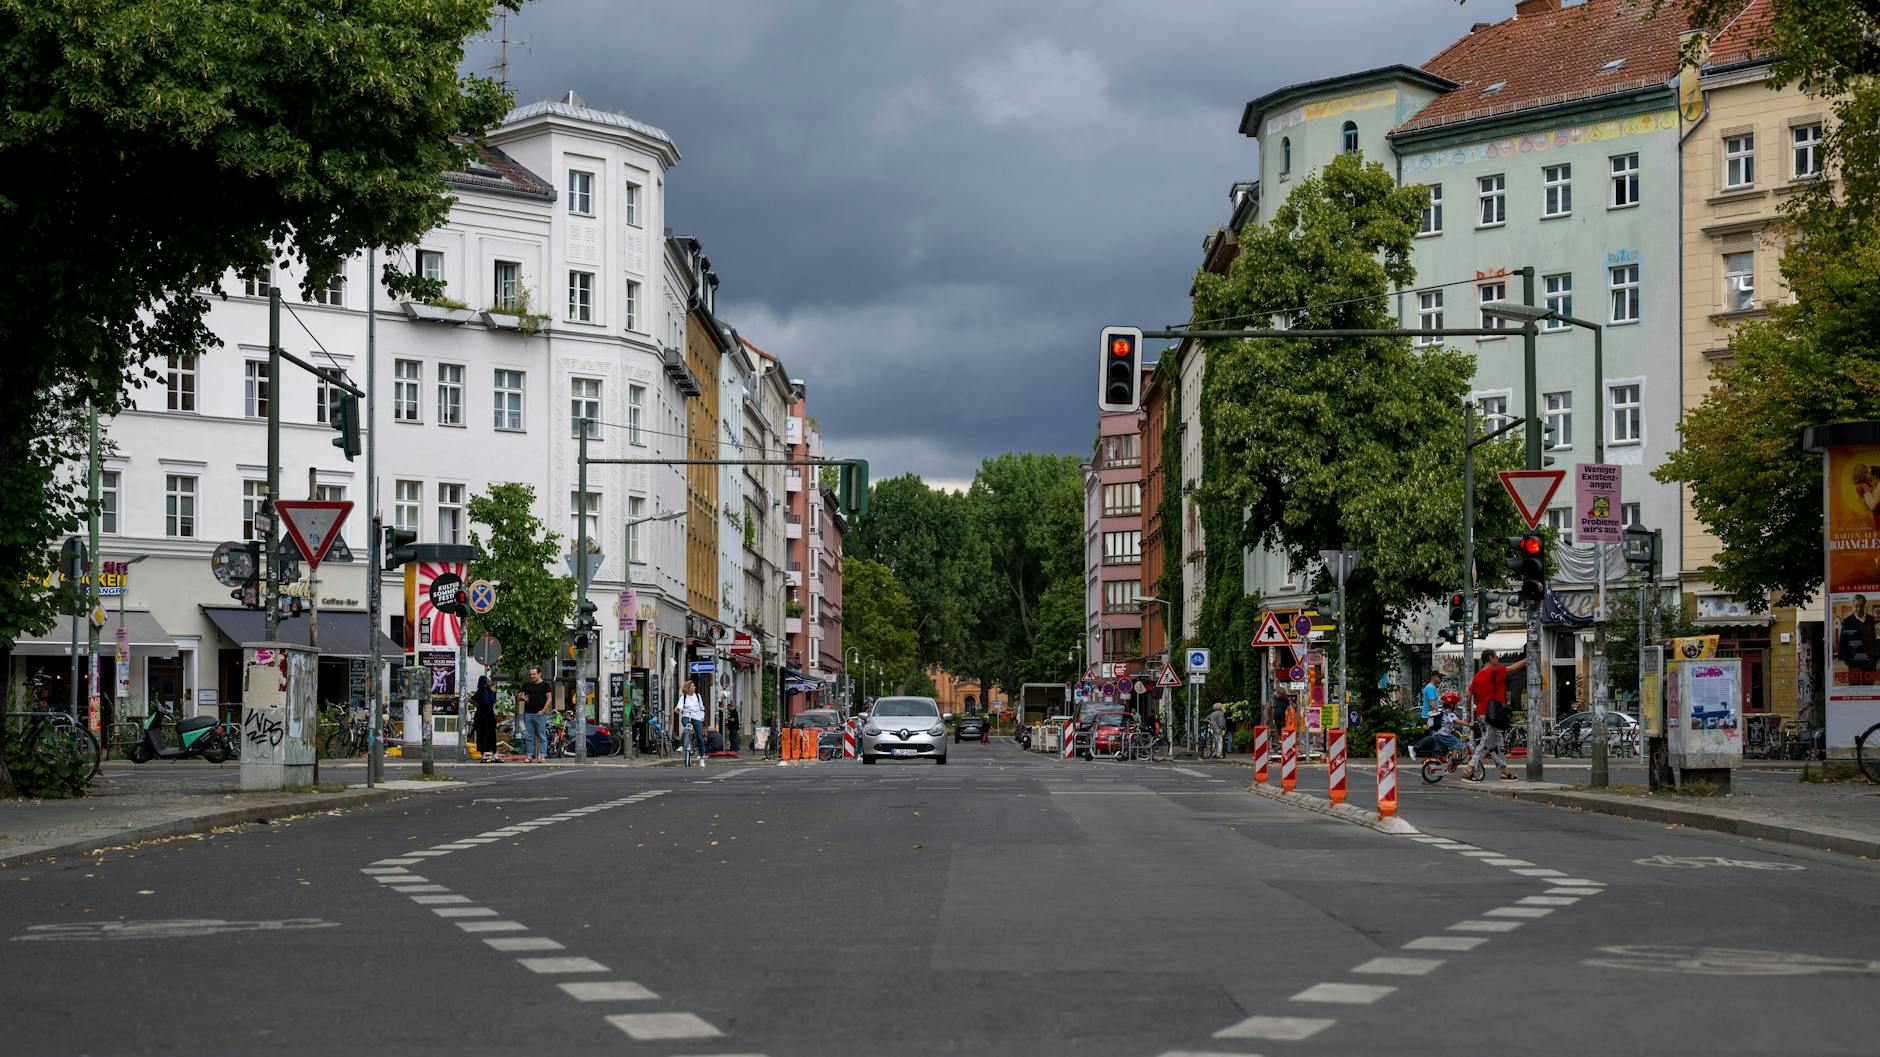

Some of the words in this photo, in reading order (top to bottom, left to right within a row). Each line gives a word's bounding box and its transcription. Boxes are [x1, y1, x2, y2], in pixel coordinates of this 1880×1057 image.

[1584, 466, 1616, 474] Weniger
[1582, 473, 1618, 481] Existenz-
[1589, 481, 1612, 489] angst
[1582, 518, 1619, 526] Probieren
[438, 582, 460, 591] KULTUR
